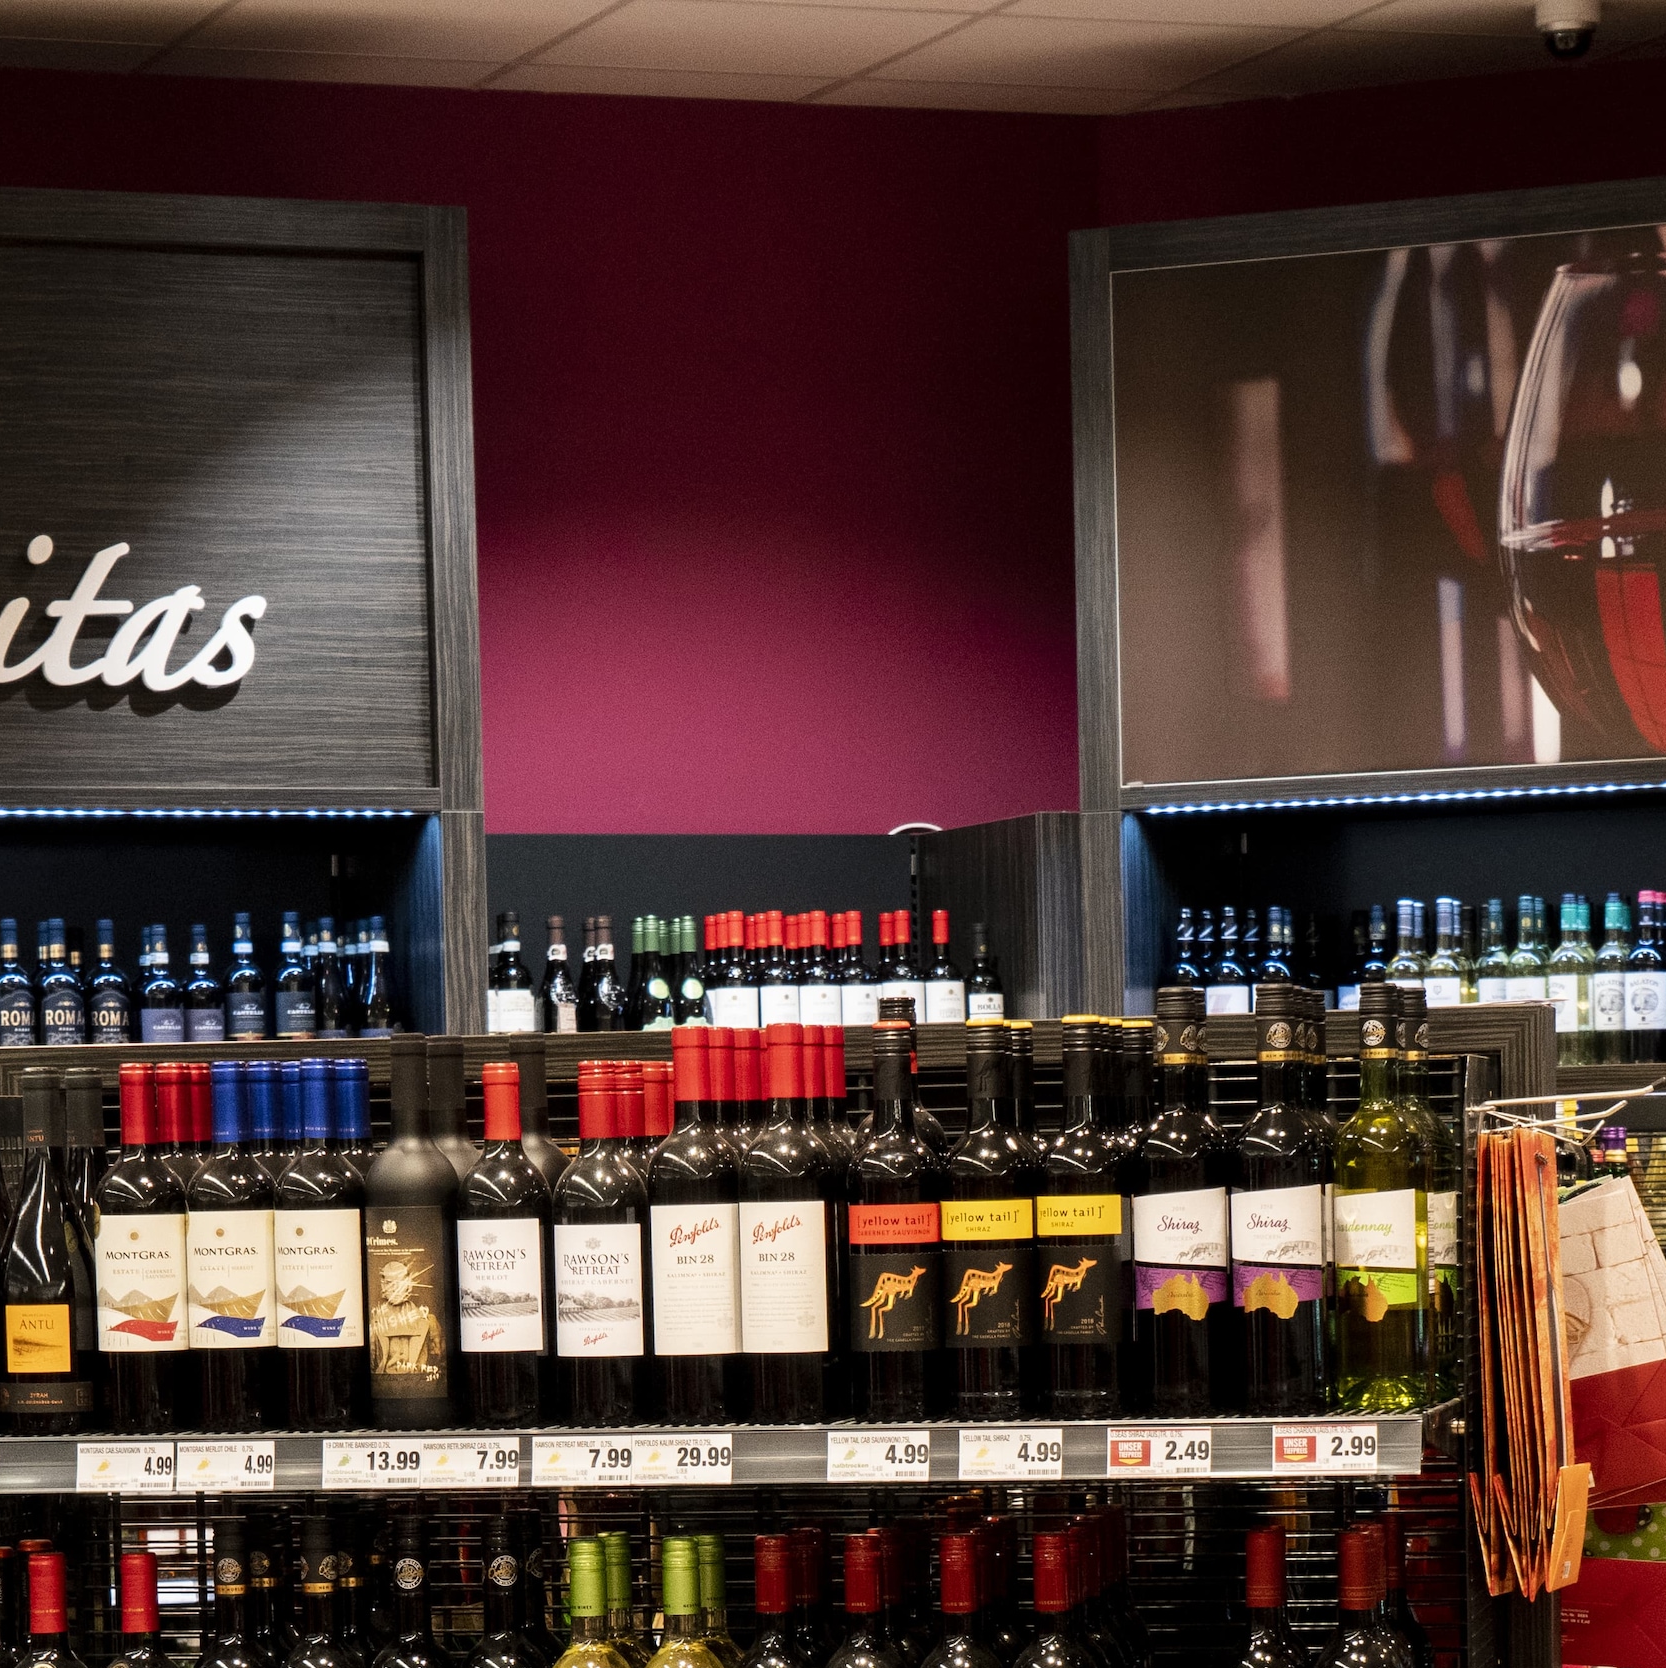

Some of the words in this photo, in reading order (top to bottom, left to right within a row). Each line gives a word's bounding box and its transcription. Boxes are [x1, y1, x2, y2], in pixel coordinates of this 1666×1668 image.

[1157, 1215, 1202, 1232] Shiraz
[1247, 1213, 1291, 1230] Shiraz
[463, 1249, 526, 1271] RAWSON'S
[470, 1261, 516, 1270] RETREAT
[563, 1253, 629, 1275] RAWSON'S
[677, 1255, 697, 1265] BIN
[700, 1254, 714, 1264] 28
[759, 1253, 777, 1262] BIN
[780, 1252, 795, 1262] 28
[572, 1265, 619, 1275] RETREAT
[20, 1319, 54, 1329] ANTU
[885, 1444, 929, 1464] 4.99
[1018, 1442, 1061, 1462] 4.99
[1118, 1442, 1140, 1450] UNSER
[1166, 1441, 1210, 1461] 2.49
[1331, 1437, 1376, 1457] 2.99
[245, 1455, 272, 1473] 4.99
[367, 1451, 420, 1470] 13.99
[477, 1450, 519, 1469] 7.99
[589, 1448, 631, 1467] 7.99
[677, 1446, 731, 1467] 29.99
[145, 1457, 172, 1475] 4.99
